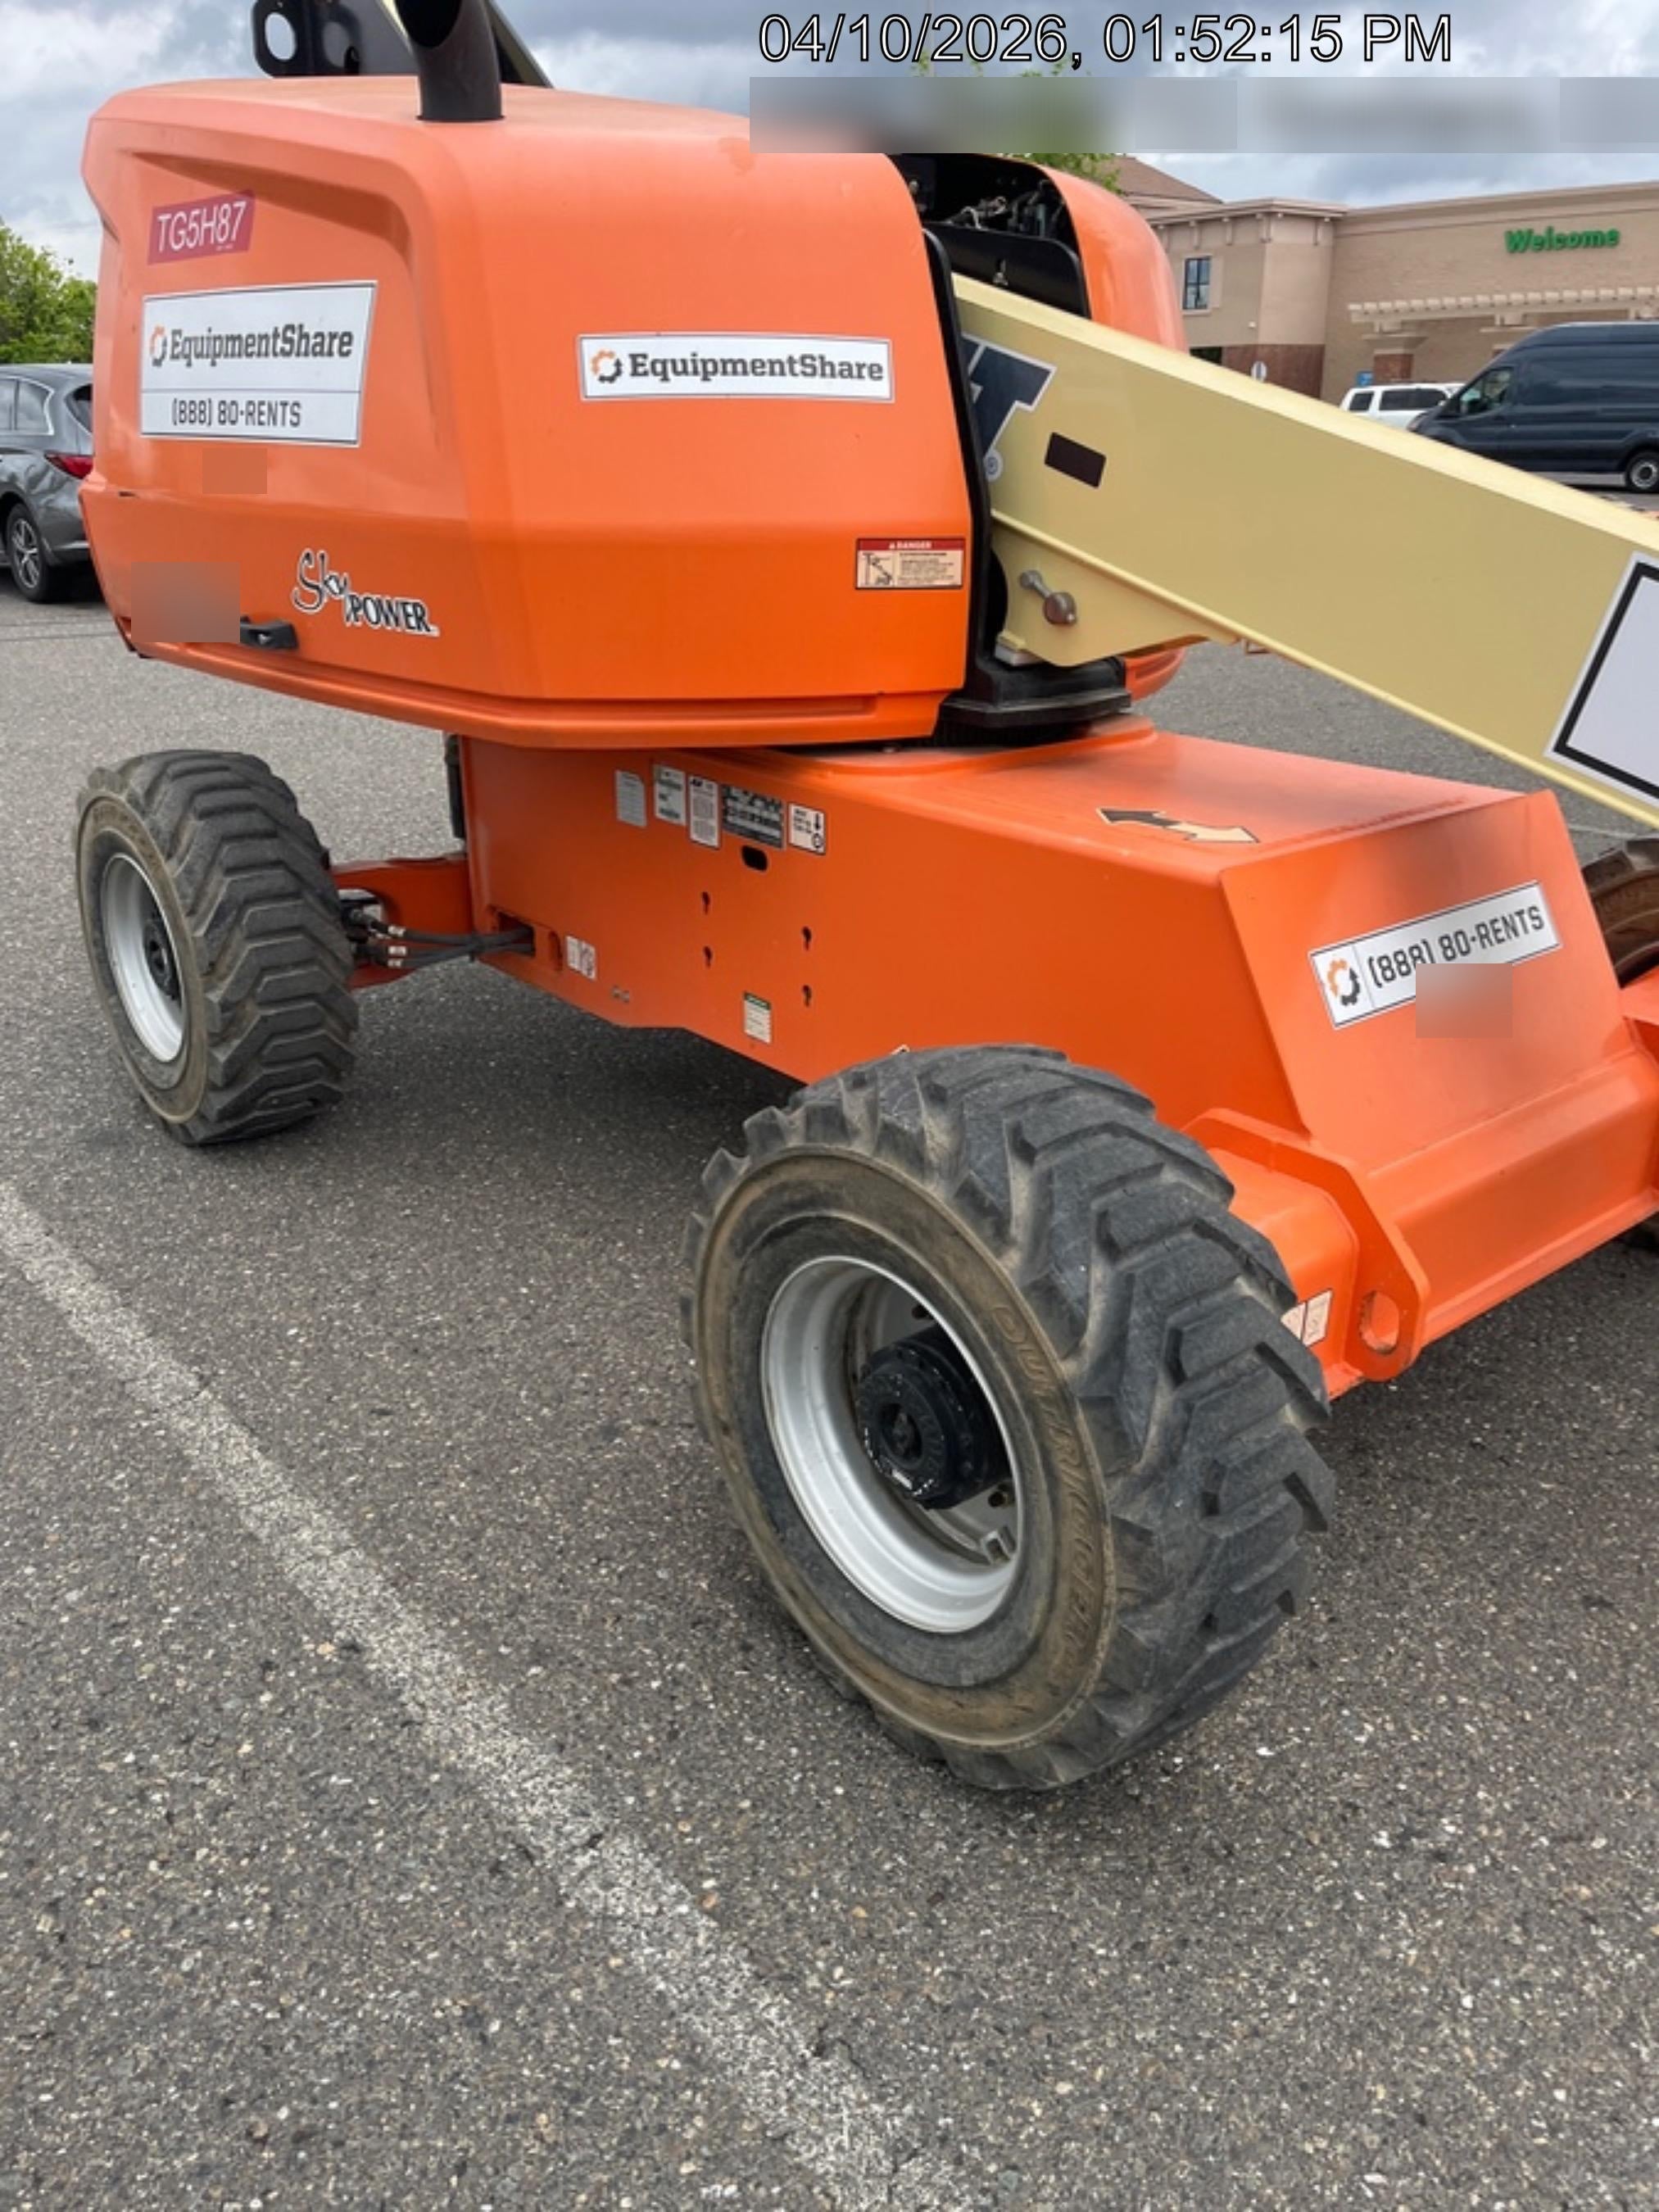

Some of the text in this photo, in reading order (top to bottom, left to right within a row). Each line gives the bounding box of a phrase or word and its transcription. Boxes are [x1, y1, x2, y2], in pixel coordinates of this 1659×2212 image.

[156, 201, 247, 253] TG5H87
[1504, 225, 1620, 254] Welcome
[169, 323, 354, 368] EquipmentShare
[628, 352, 885, 383] EquipmentShare
[172, 398, 212, 427] (888)
[896, 541, 932, 549] DANGER
